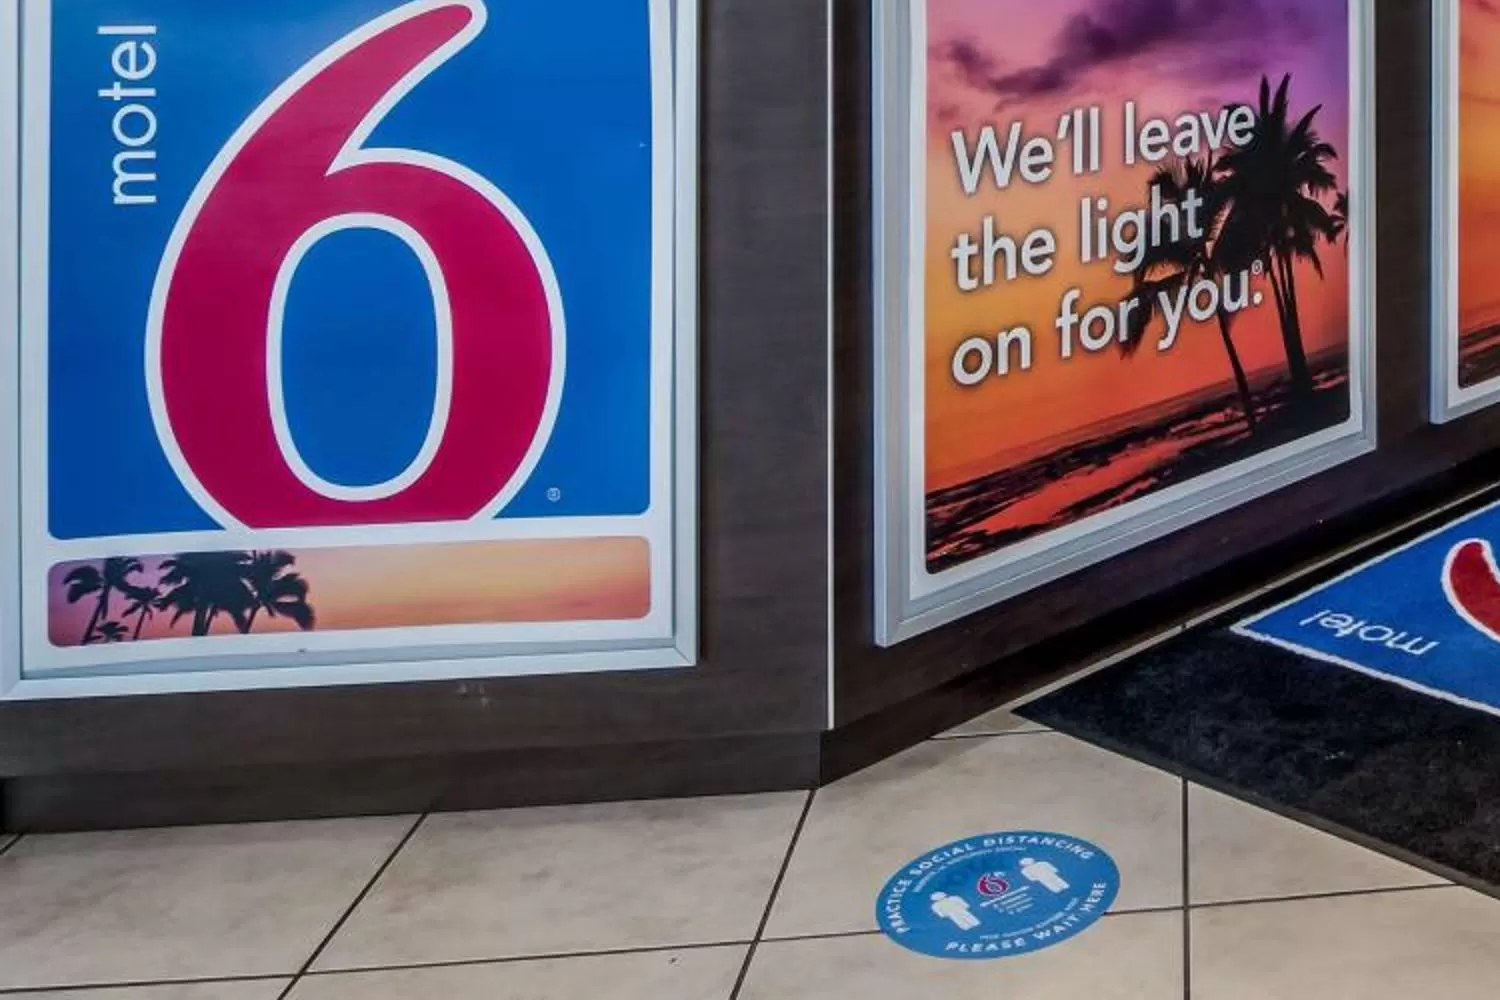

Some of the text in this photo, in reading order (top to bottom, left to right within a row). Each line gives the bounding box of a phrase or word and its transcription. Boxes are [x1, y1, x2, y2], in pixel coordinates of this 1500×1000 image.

[97, 23, 158, 206] motel
[951, 101, 1256, 195] We'll leave
[951, 185, 1204, 291] the light
[951, 325, 1032, 386] on
[1055, 287, 1139, 359] for
[1299, 608, 1440, 655] motel
[885, 879, 912, 934] PRACTICE
[909, 843, 977, 876] SOCIAL
[983, 835, 1095, 860] DISTANCING
[945, 938, 1026, 953] PLEASE
[1032, 913, 1080, 941] WAIT
[1079, 880, 1107, 913] HERE
